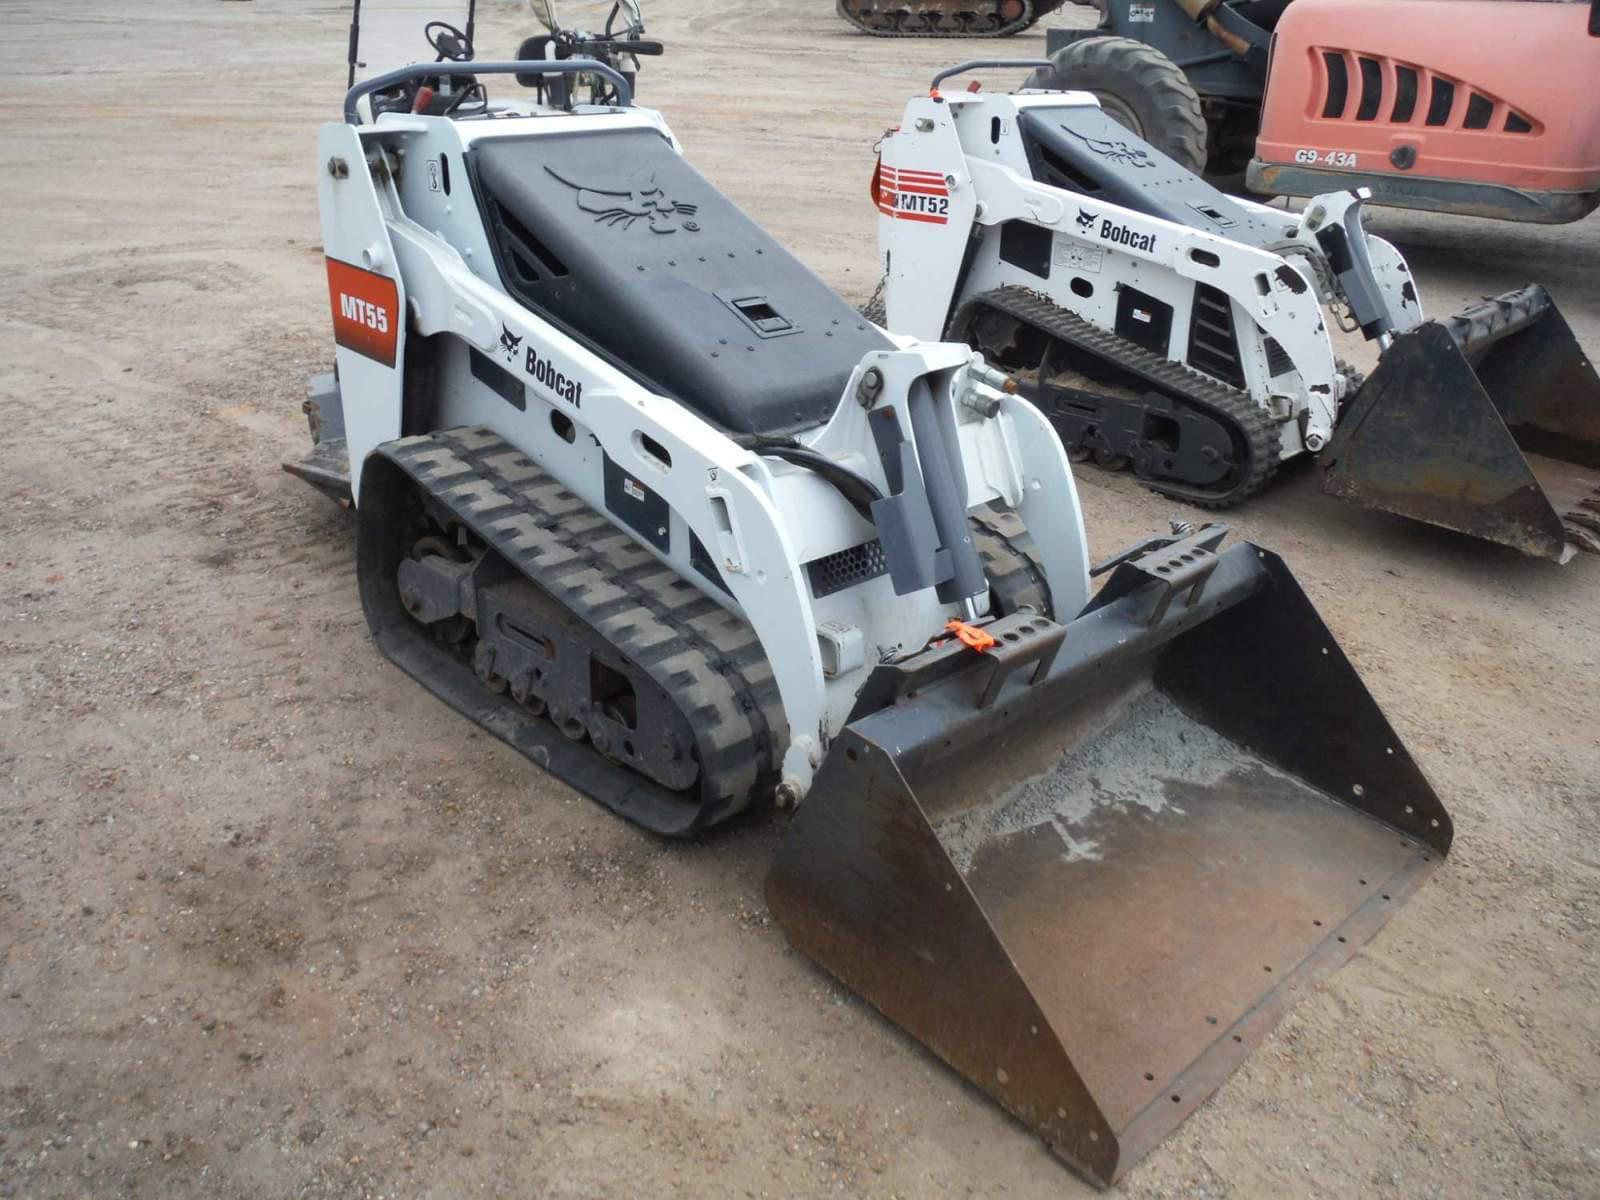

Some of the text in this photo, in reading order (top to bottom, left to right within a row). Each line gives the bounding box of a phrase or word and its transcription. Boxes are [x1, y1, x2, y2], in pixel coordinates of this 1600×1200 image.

[1295, 149, 1357, 168] G9-43A
[901, 193, 949, 215] MT52
[1100, 219, 1156, 253] Bobcat
[340, 292, 388, 333] MT55
[525, 345, 582, 409] Bobcat
